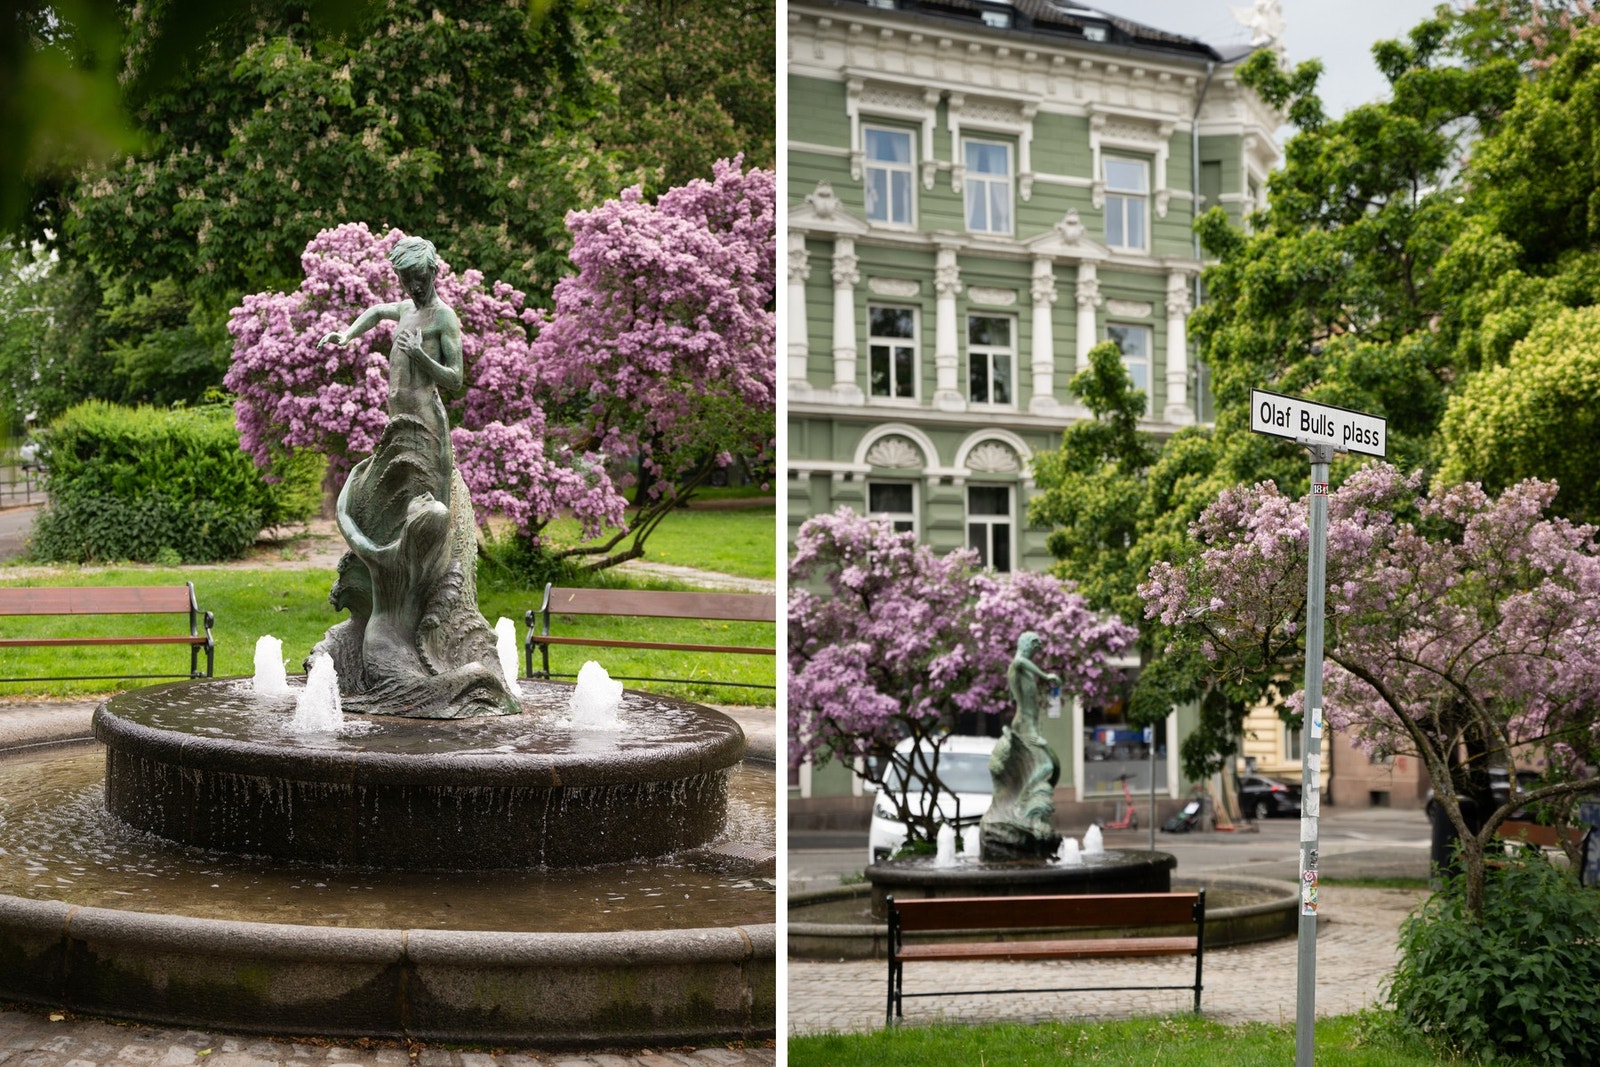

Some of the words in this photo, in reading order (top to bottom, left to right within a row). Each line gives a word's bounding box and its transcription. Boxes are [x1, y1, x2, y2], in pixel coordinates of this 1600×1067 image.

[1260, 401, 1291, 428] Olaf
[1300, 409, 1335, 437] Bulls
[1343, 421, 1379, 447] plass
